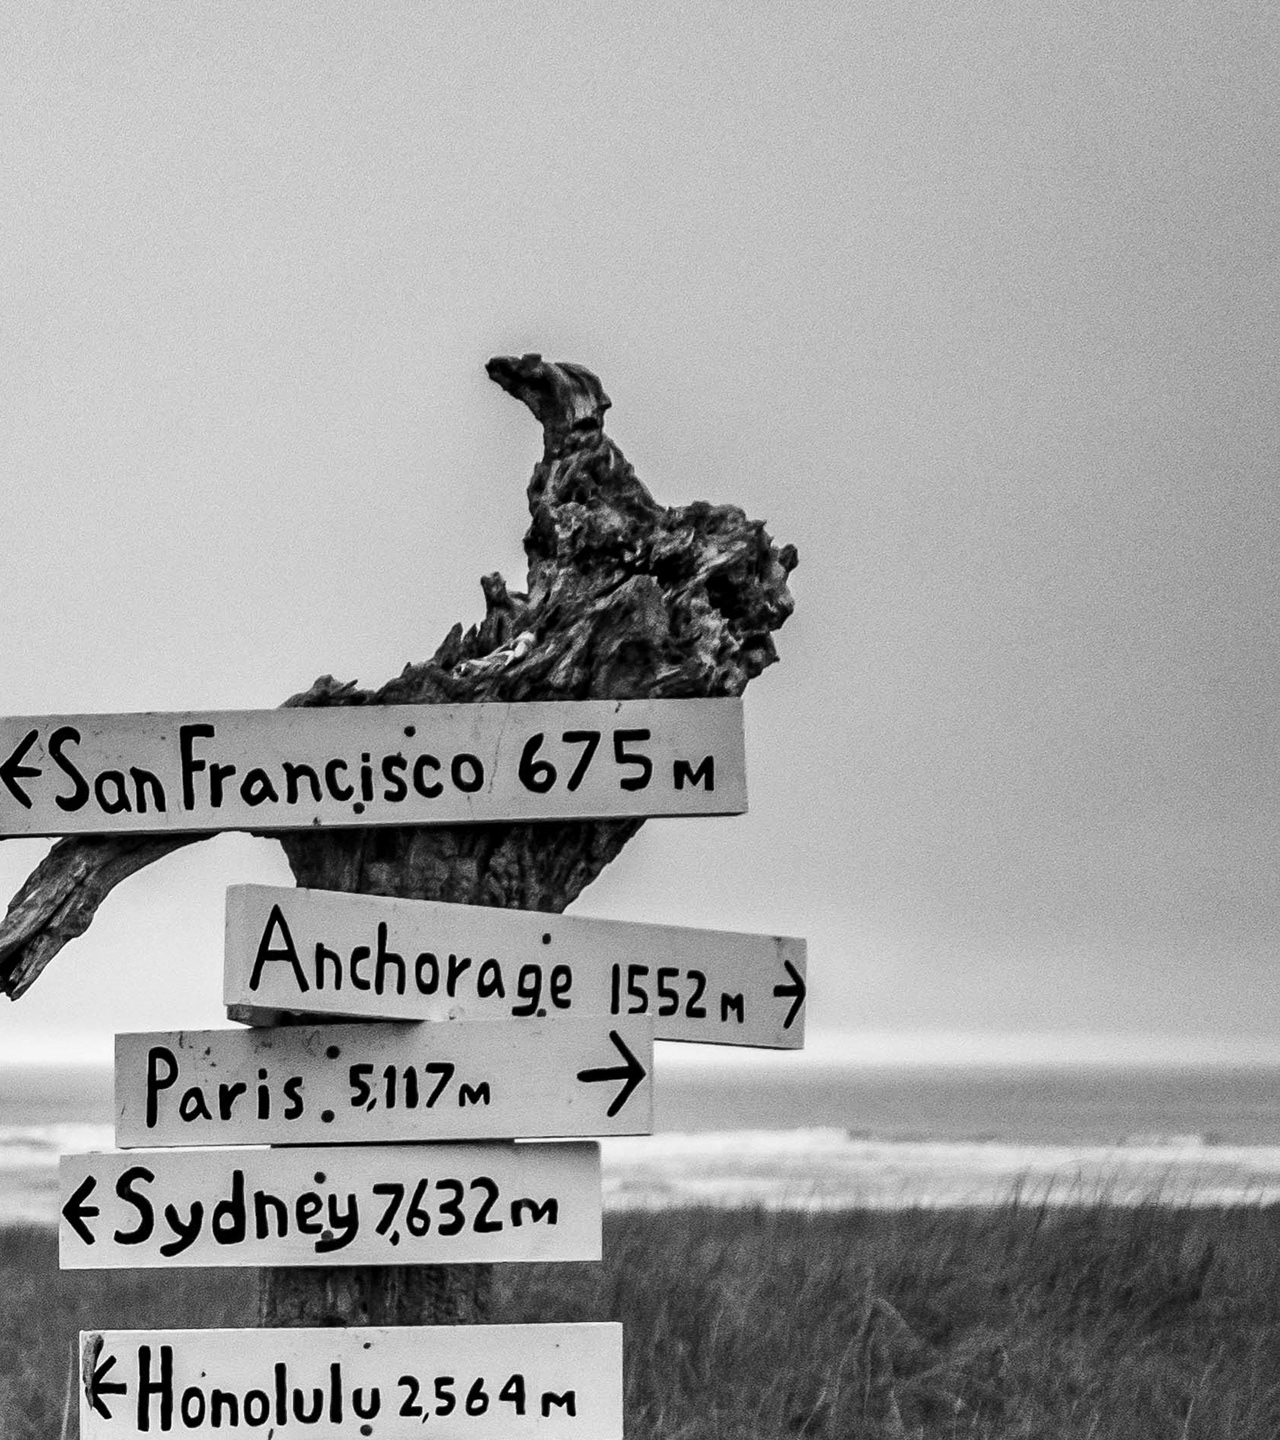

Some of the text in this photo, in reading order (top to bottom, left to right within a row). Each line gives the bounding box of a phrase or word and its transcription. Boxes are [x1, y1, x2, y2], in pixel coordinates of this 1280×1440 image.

[47, 725, 167, 815] San
[178, 723, 485, 811] Francisco
[249, 903, 573, 1017] Anchorage
[113, 1166, 359, 1258] Sydney
[137, 1345, 381, 1432] Honolulu
